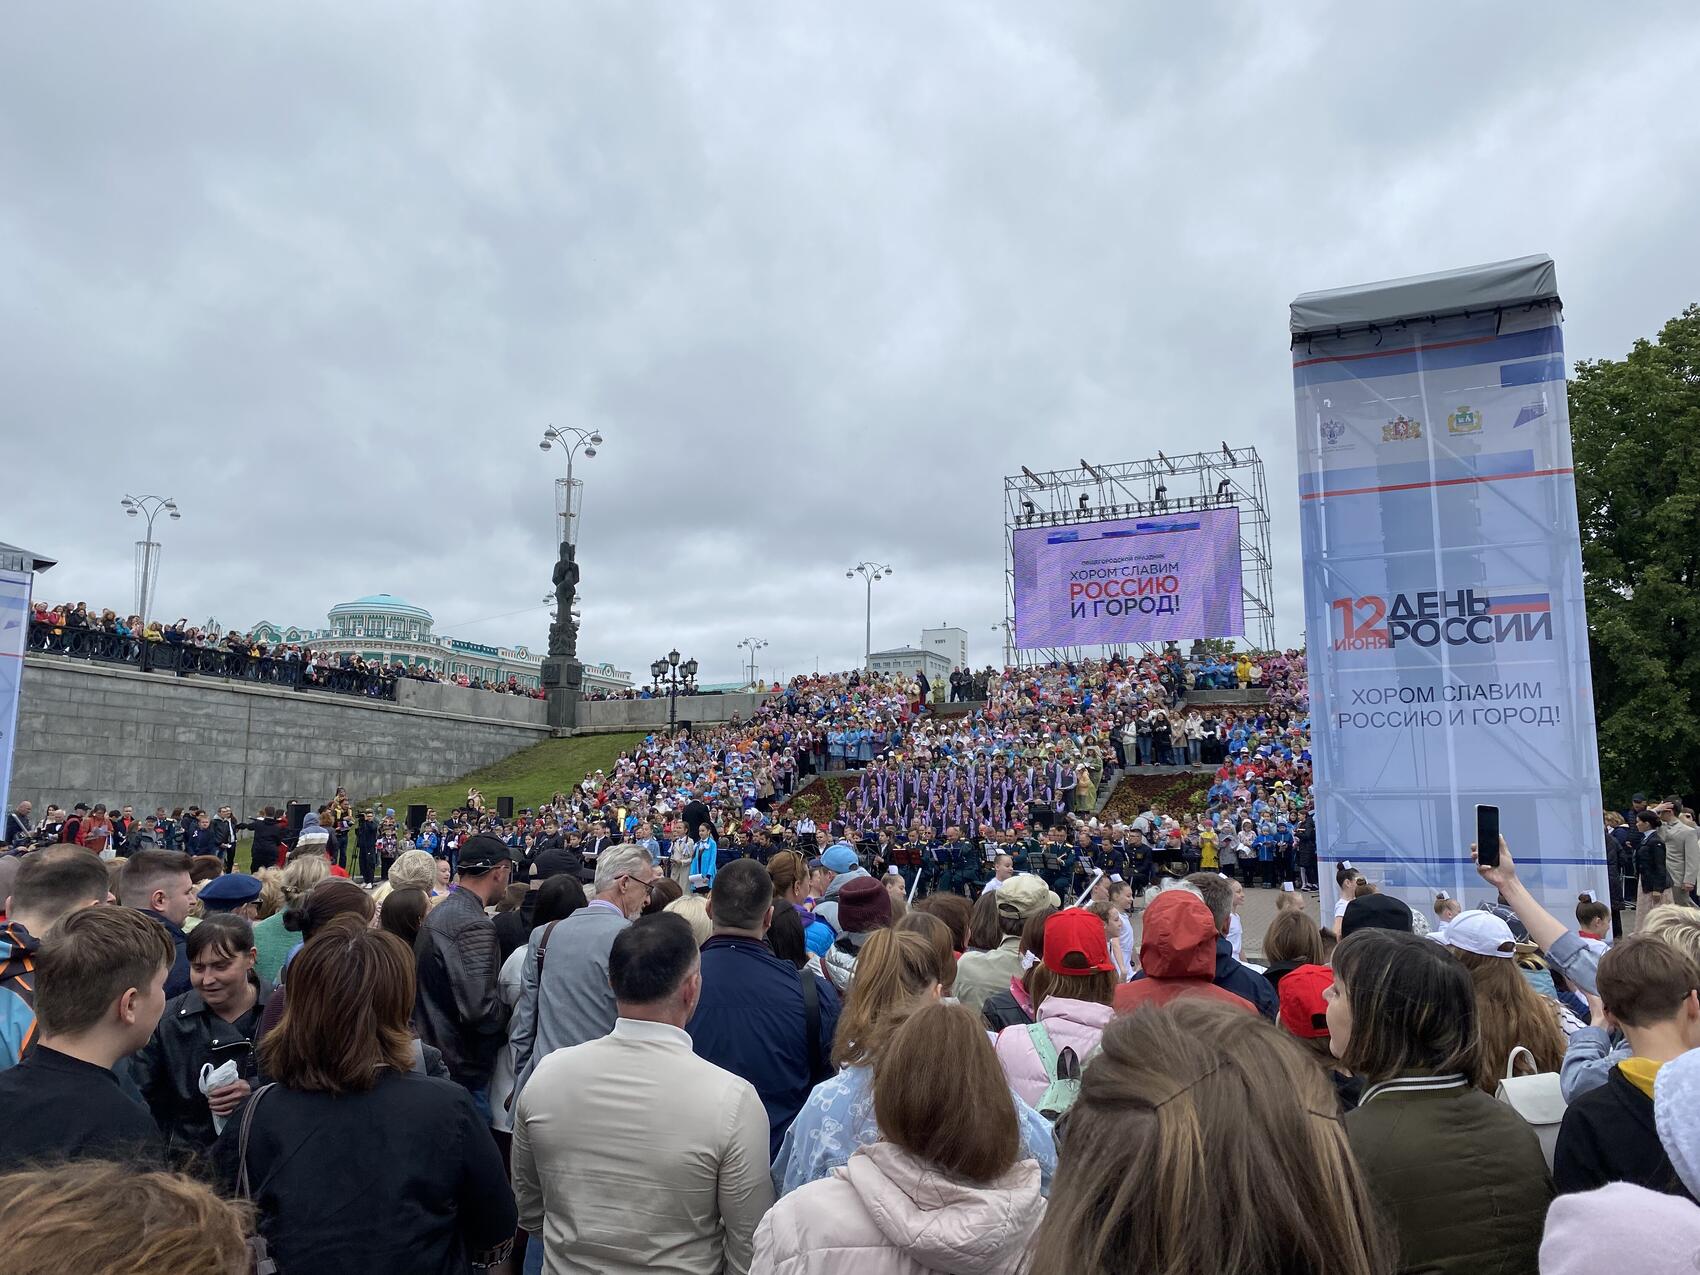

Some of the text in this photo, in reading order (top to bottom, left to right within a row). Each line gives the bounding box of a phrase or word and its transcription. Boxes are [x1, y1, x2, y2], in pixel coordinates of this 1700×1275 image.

[1070, 562, 1179, 581] ХОРОМ СЛАВИМ
[1070, 574, 1179, 600] РОССИЮ
[1071, 594, 1180, 618] И ГОРОД!
[1387, 589, 1490, 620] ДЕНЬ
[1332, 595, 1388, 640] 12
[1388, 612, 1553, 648] РОССИИ
[1334, 637, 1389, 651] ИЮНЯ
[1351, 682, 1542, 705] ХОРОМ СЛАВИМ
[1338, 706, 1561, 728] РОССИЮ И ГОРОД!
